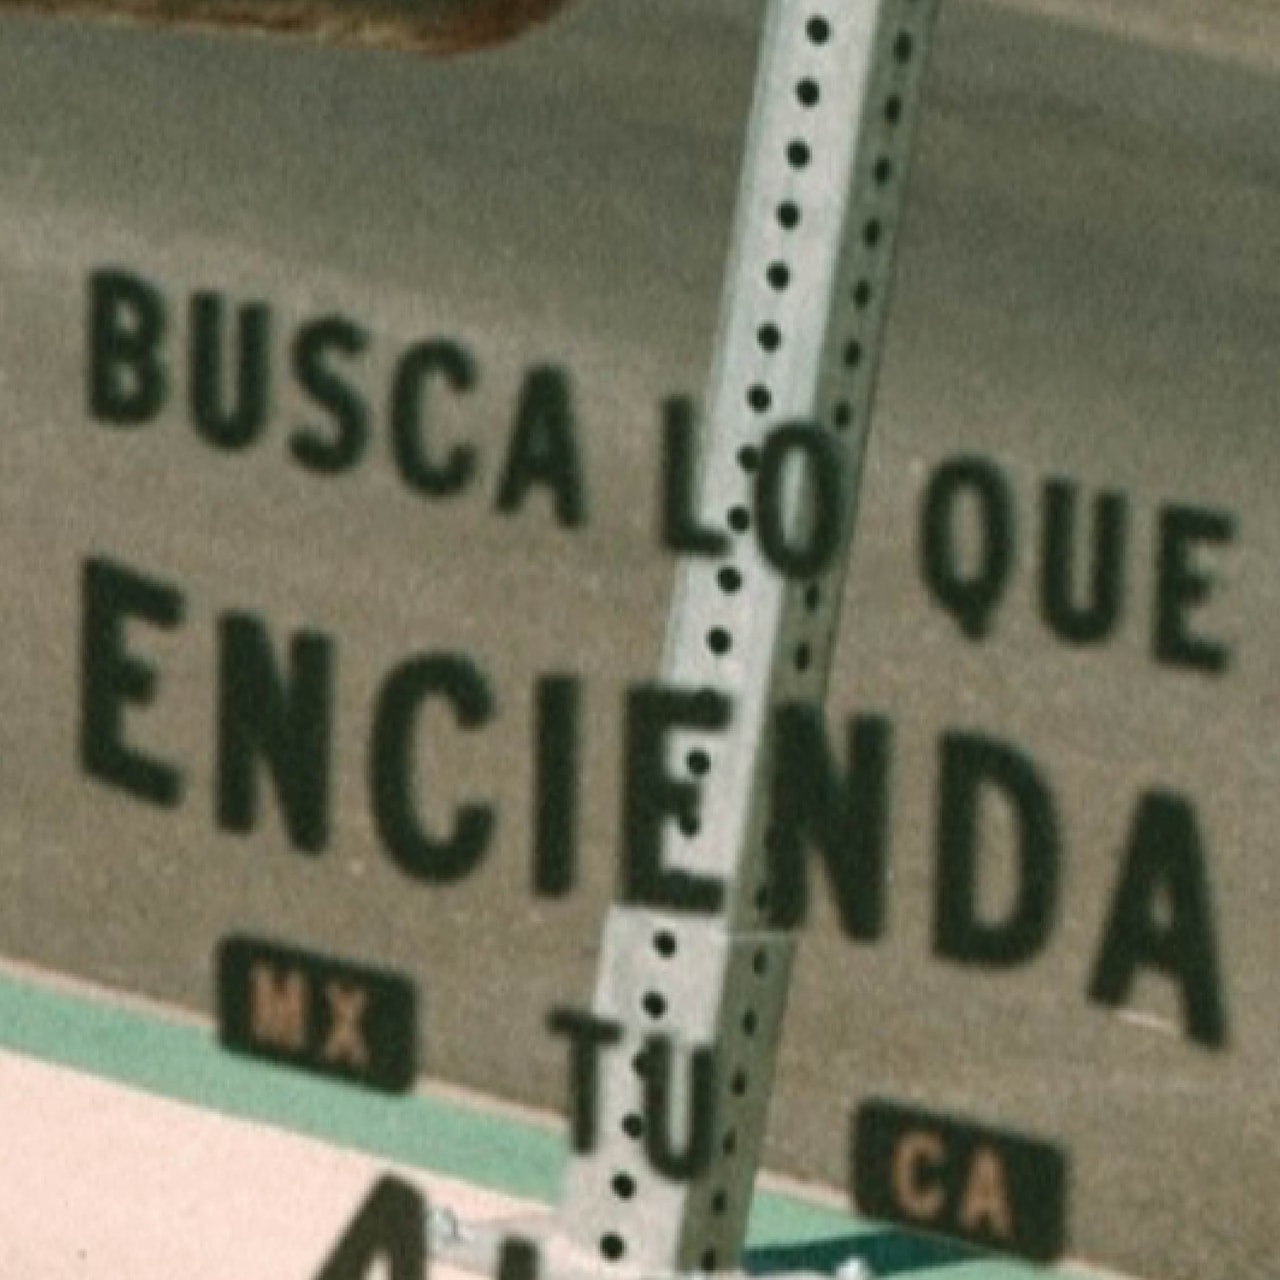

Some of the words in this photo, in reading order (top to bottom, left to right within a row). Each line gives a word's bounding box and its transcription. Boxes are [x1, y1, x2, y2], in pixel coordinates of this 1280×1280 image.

[87, 267, 587, 529] BUSCA
[659, 395, 842, 580] LO
[918, 453, 1236, 676] QUE
[78, 554, 1228, 1047] ENCIENDA
[250, 960, 370, 1068] MX
[546, 1006, 717, 1182] TU
[890, 1131, 1016, 1240] CA
